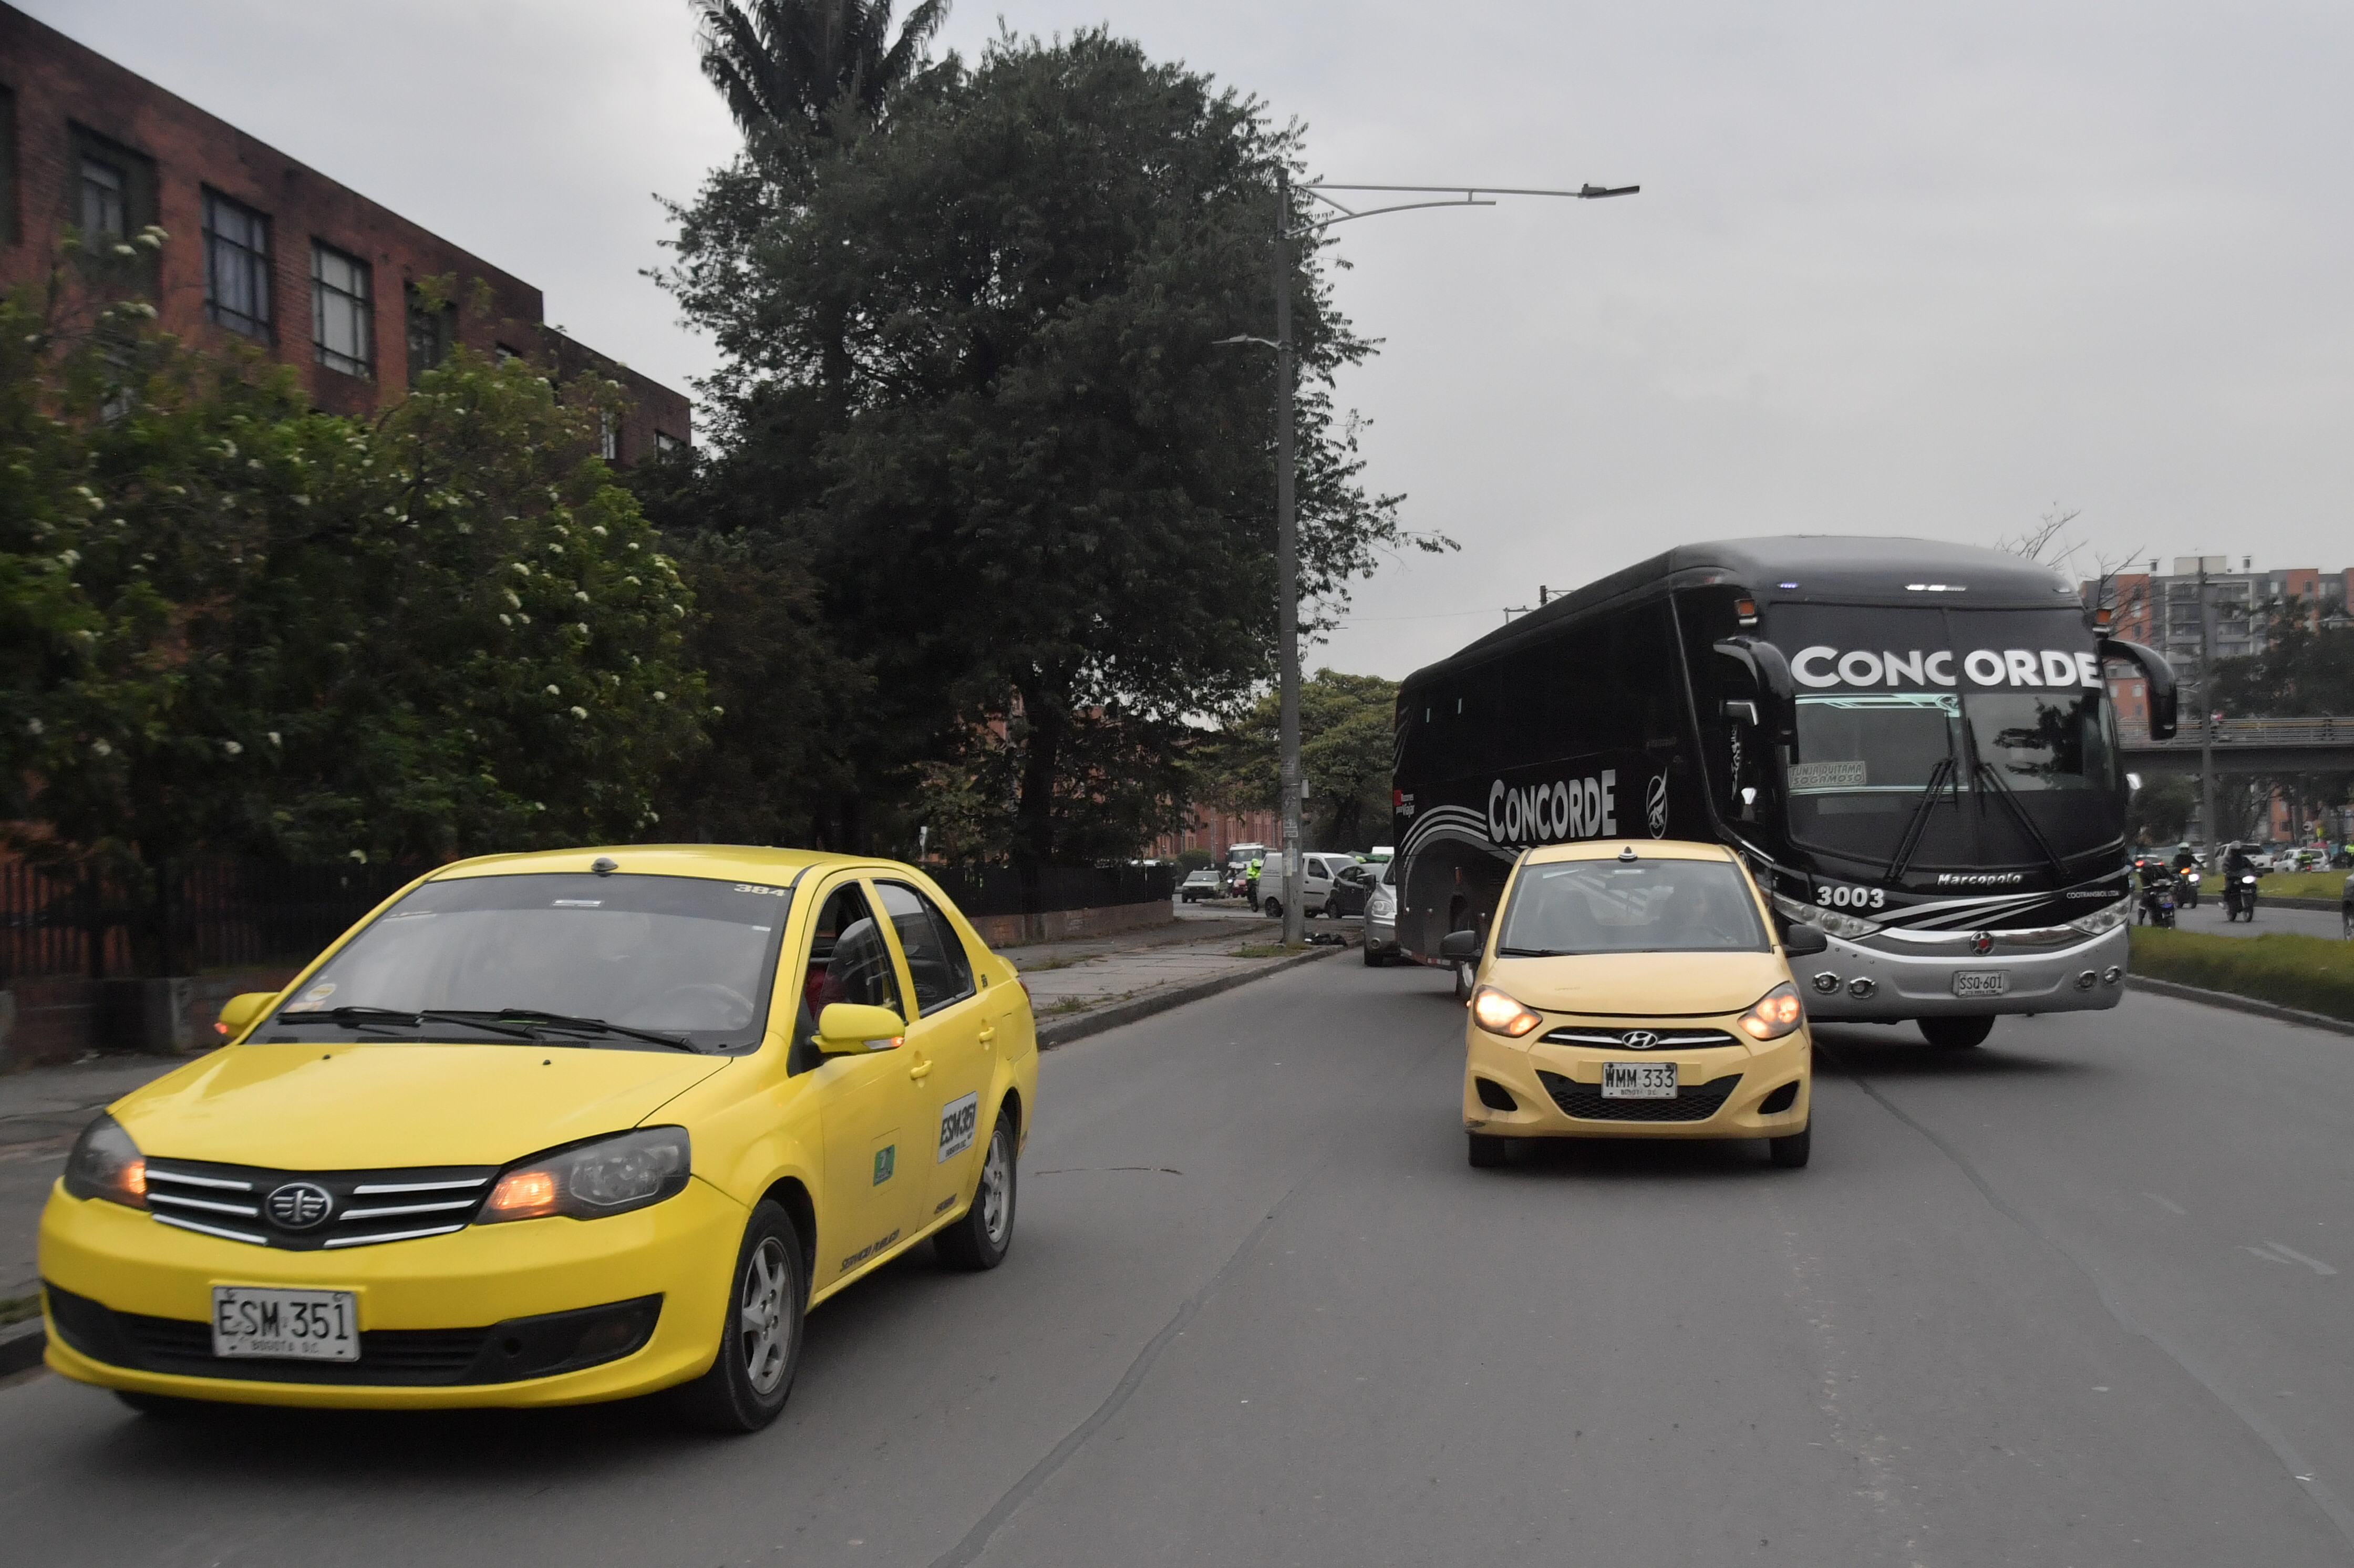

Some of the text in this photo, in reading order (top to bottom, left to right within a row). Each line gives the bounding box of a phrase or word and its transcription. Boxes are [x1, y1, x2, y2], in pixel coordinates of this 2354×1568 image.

[1791, 764, 1862, 777] TUNJA DUITAMA
[1792, 774, 1863, 785] SOGAMOSO
[1489, 769, 1617, 843] CONCORDE
[1937, 873, 2022, 886] Marcopolo
[734, 884, 785, 896] 384
[1816, 886, 1884, 908] 3003
[1605, 1068, 1675, 1088] WMM 333
[218, 1299, 349, 1340] ESM 351
